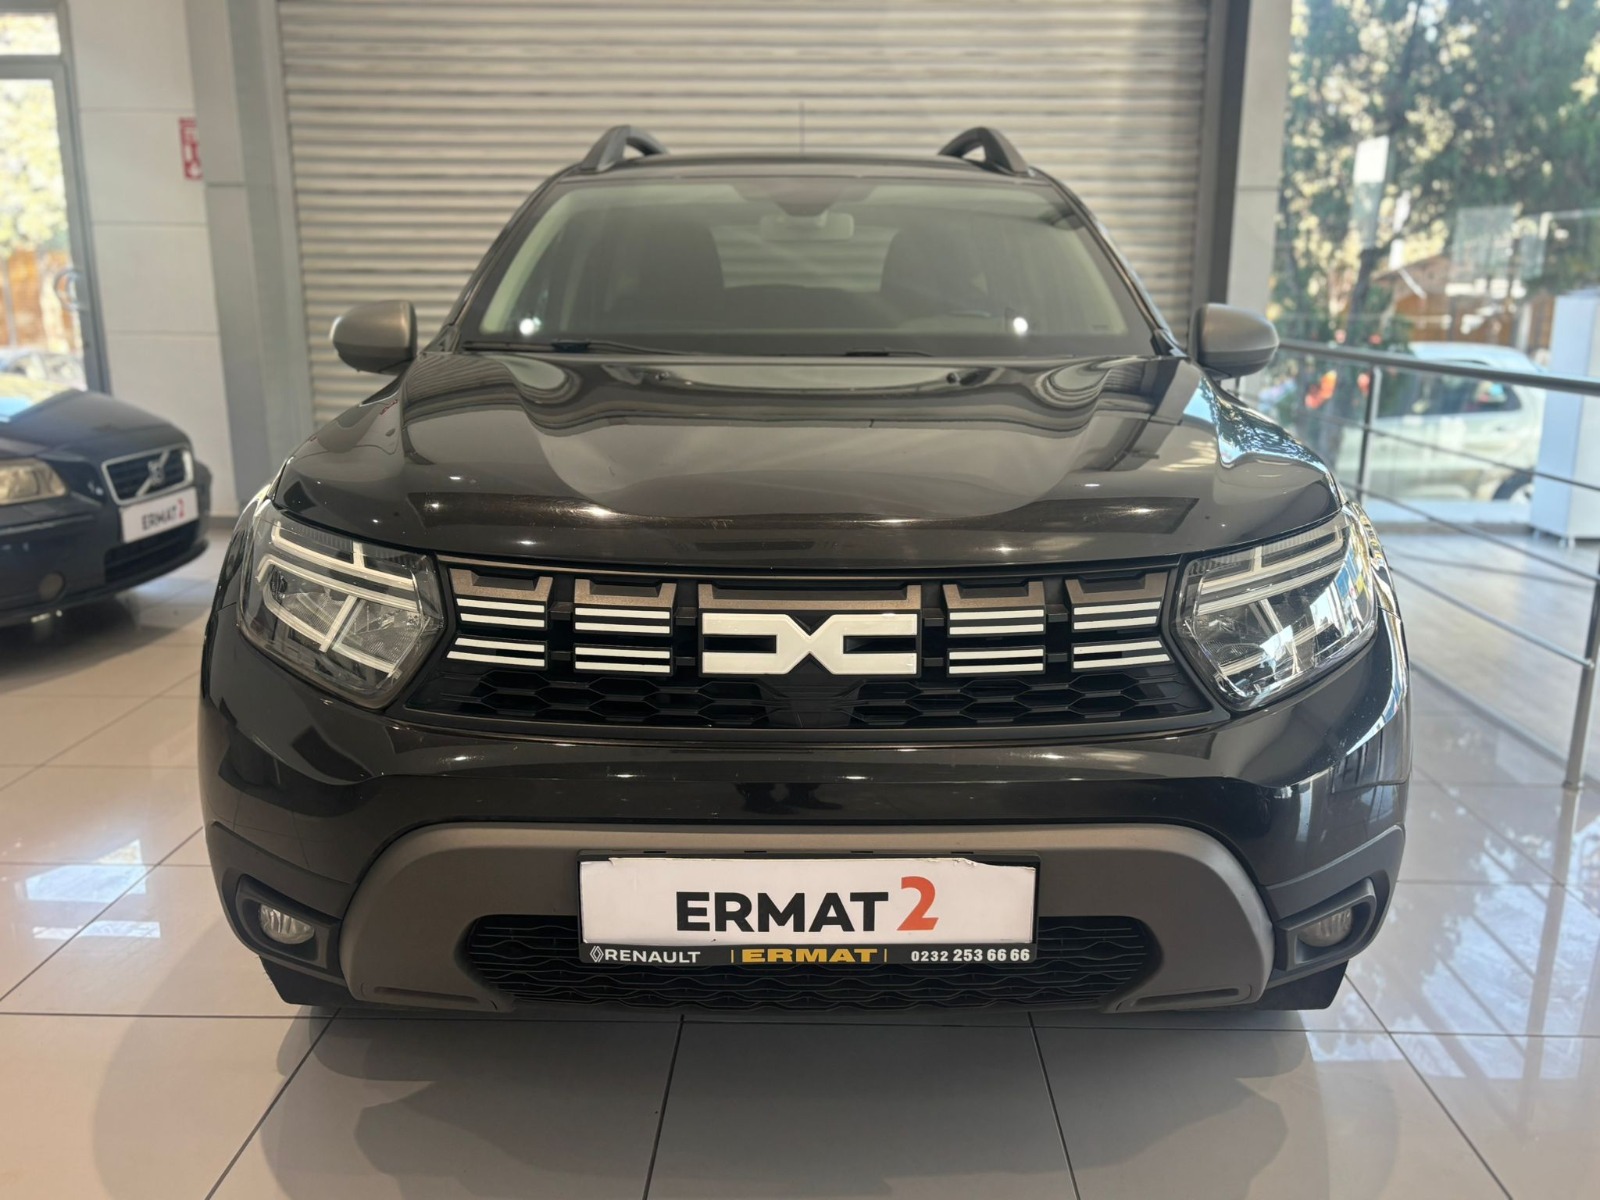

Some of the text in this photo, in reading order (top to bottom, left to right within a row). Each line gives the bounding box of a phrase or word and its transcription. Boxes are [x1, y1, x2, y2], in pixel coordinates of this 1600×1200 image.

[676, 876, 939, 933] ERMAT 2
[604, 948, 701, 963] RENAULT
[742, 948, 878, 963] ERMAT
[911, 948, 1030, 962] 0232 253 66 66
